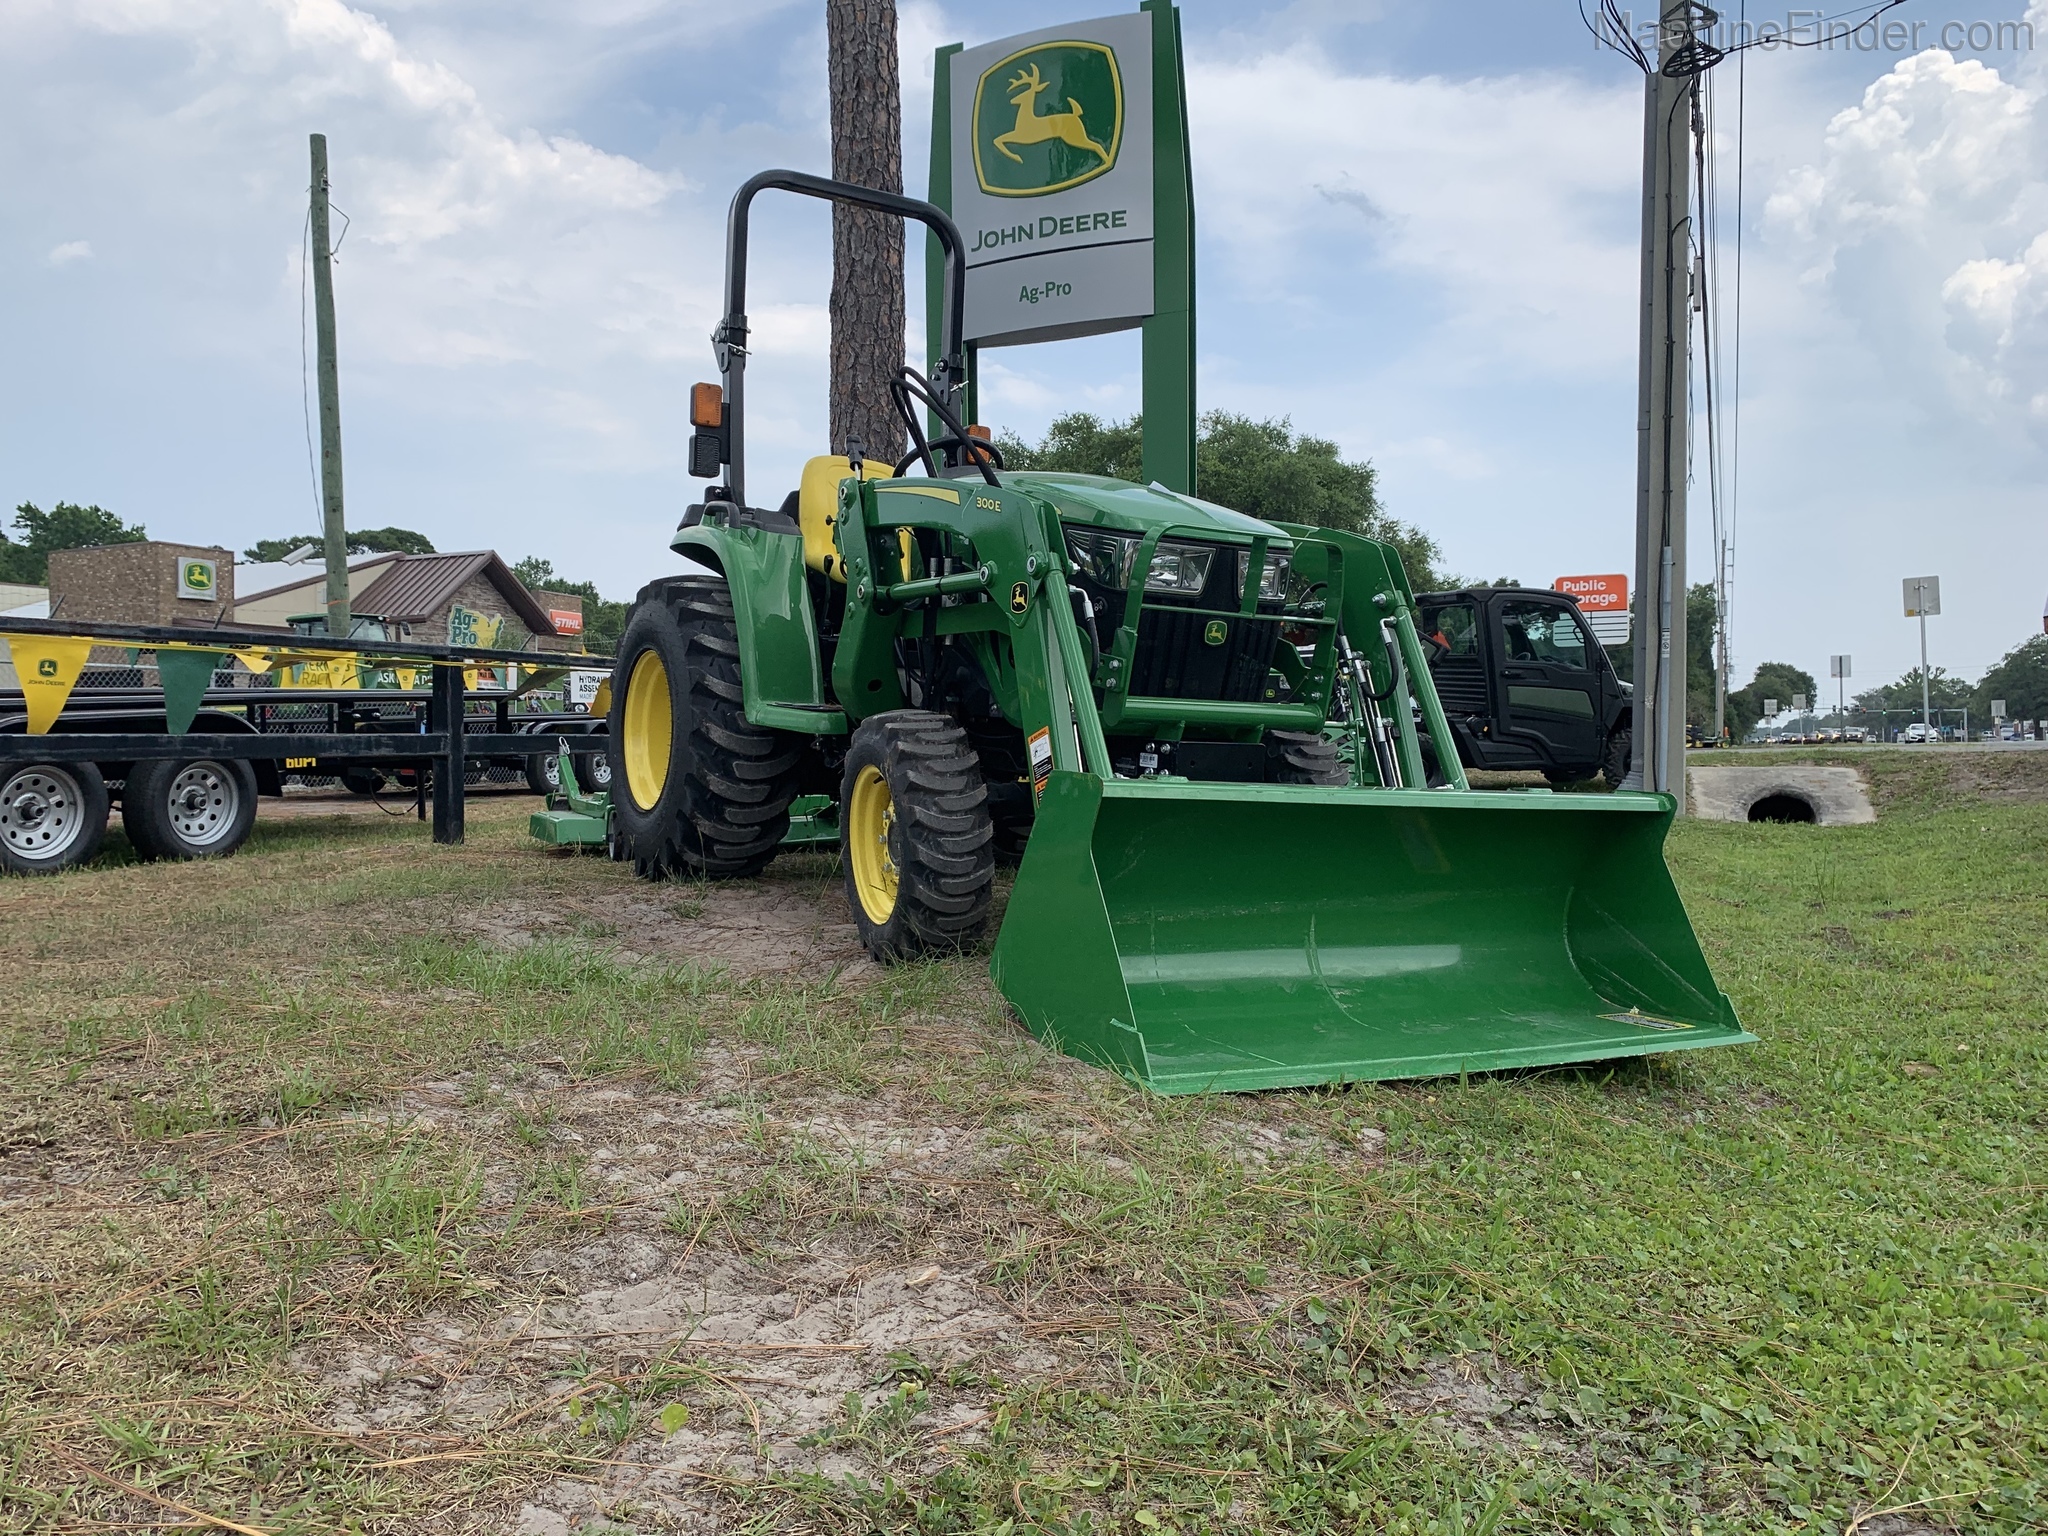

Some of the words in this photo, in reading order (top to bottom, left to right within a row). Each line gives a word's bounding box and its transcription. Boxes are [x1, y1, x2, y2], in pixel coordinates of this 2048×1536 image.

[971, 223, 1034, 252] JOHN
[1039, 210, 1127, 238] DEERE
[1019, 281, 1072, 304] Ag-Pro
[976, 496, 1002, 512] 300E
[1563, 580, 1606, 592] Public
[1573, 593, 1618, 606] orage
[451, 607, 478, 630] Ag-
[555, 618, 581, 629] STIHL
[451, 626, 477, 645] Pro
[378, 672, 395, 683] ASK
